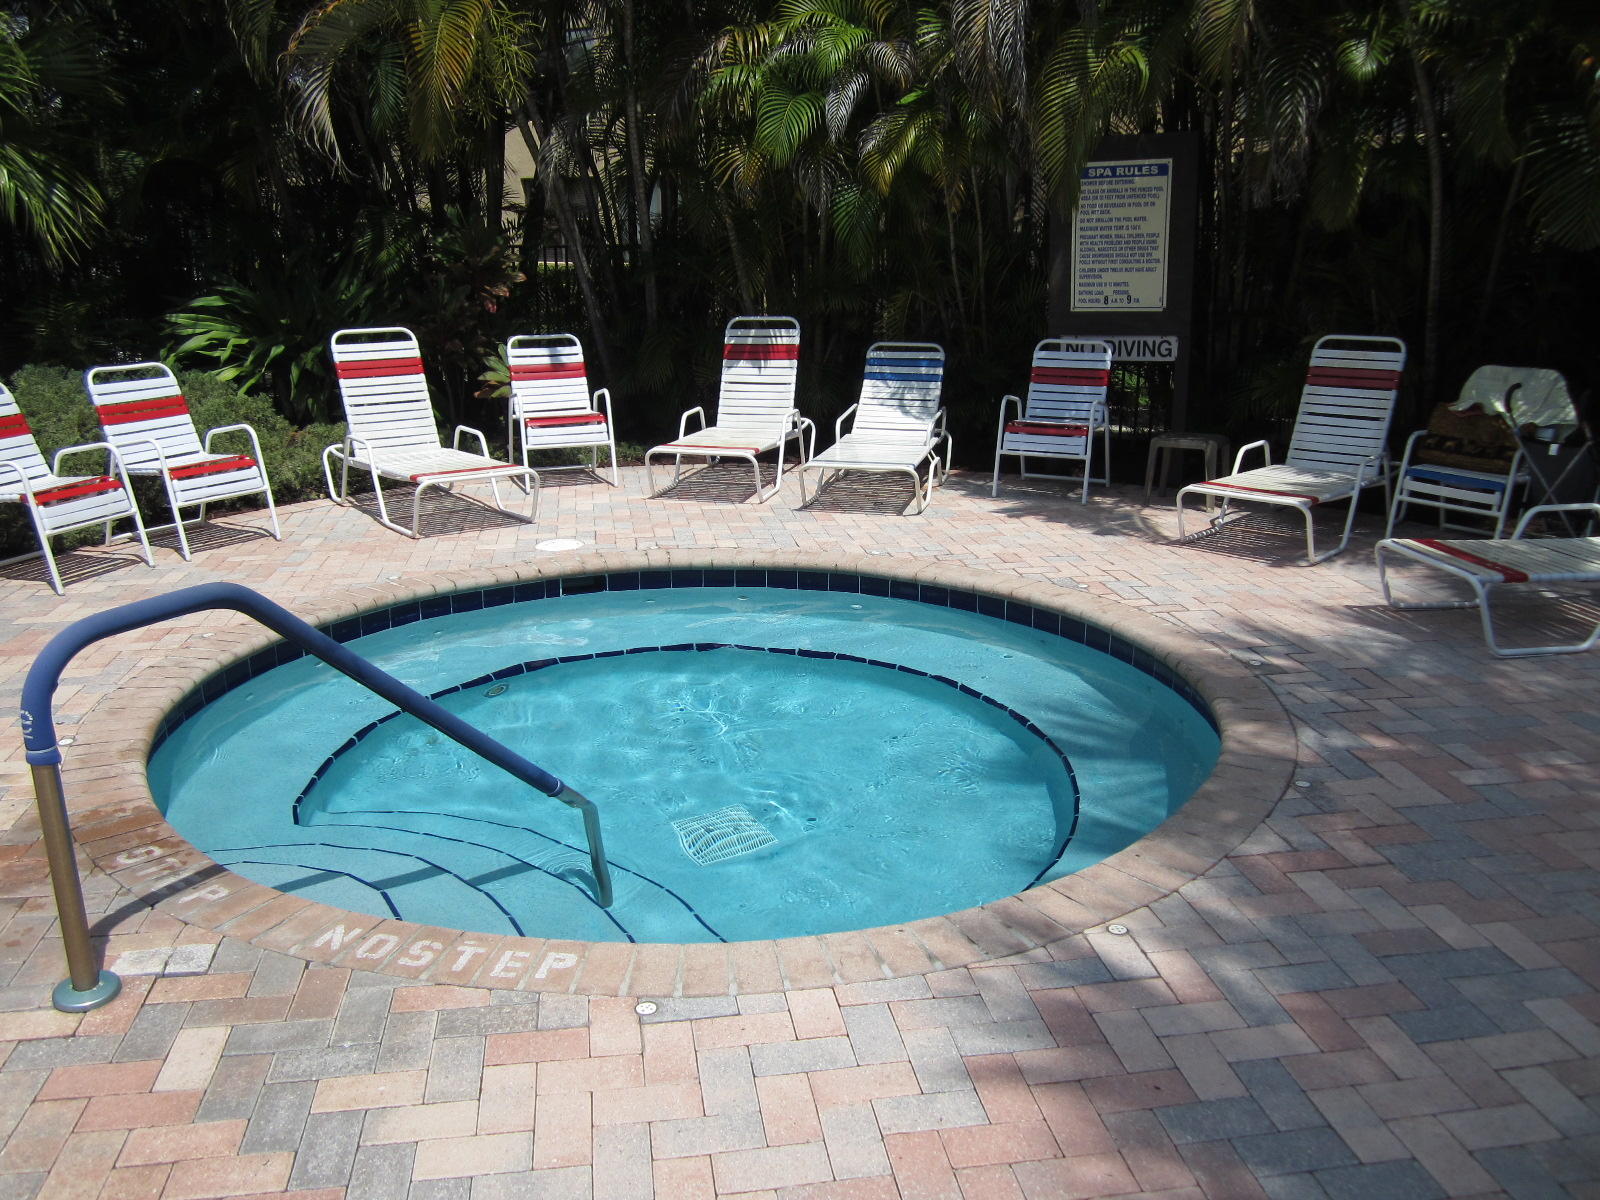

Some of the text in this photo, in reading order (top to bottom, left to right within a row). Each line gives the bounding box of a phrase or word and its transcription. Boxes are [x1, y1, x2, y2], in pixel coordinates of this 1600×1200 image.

[1088, 165, 1158, 176] SPA RULES
[1104, 296, 1108, 305] 8
[1127, 295, 1131, 304] 9
[1103, 340, 1173, 358] DIVING
